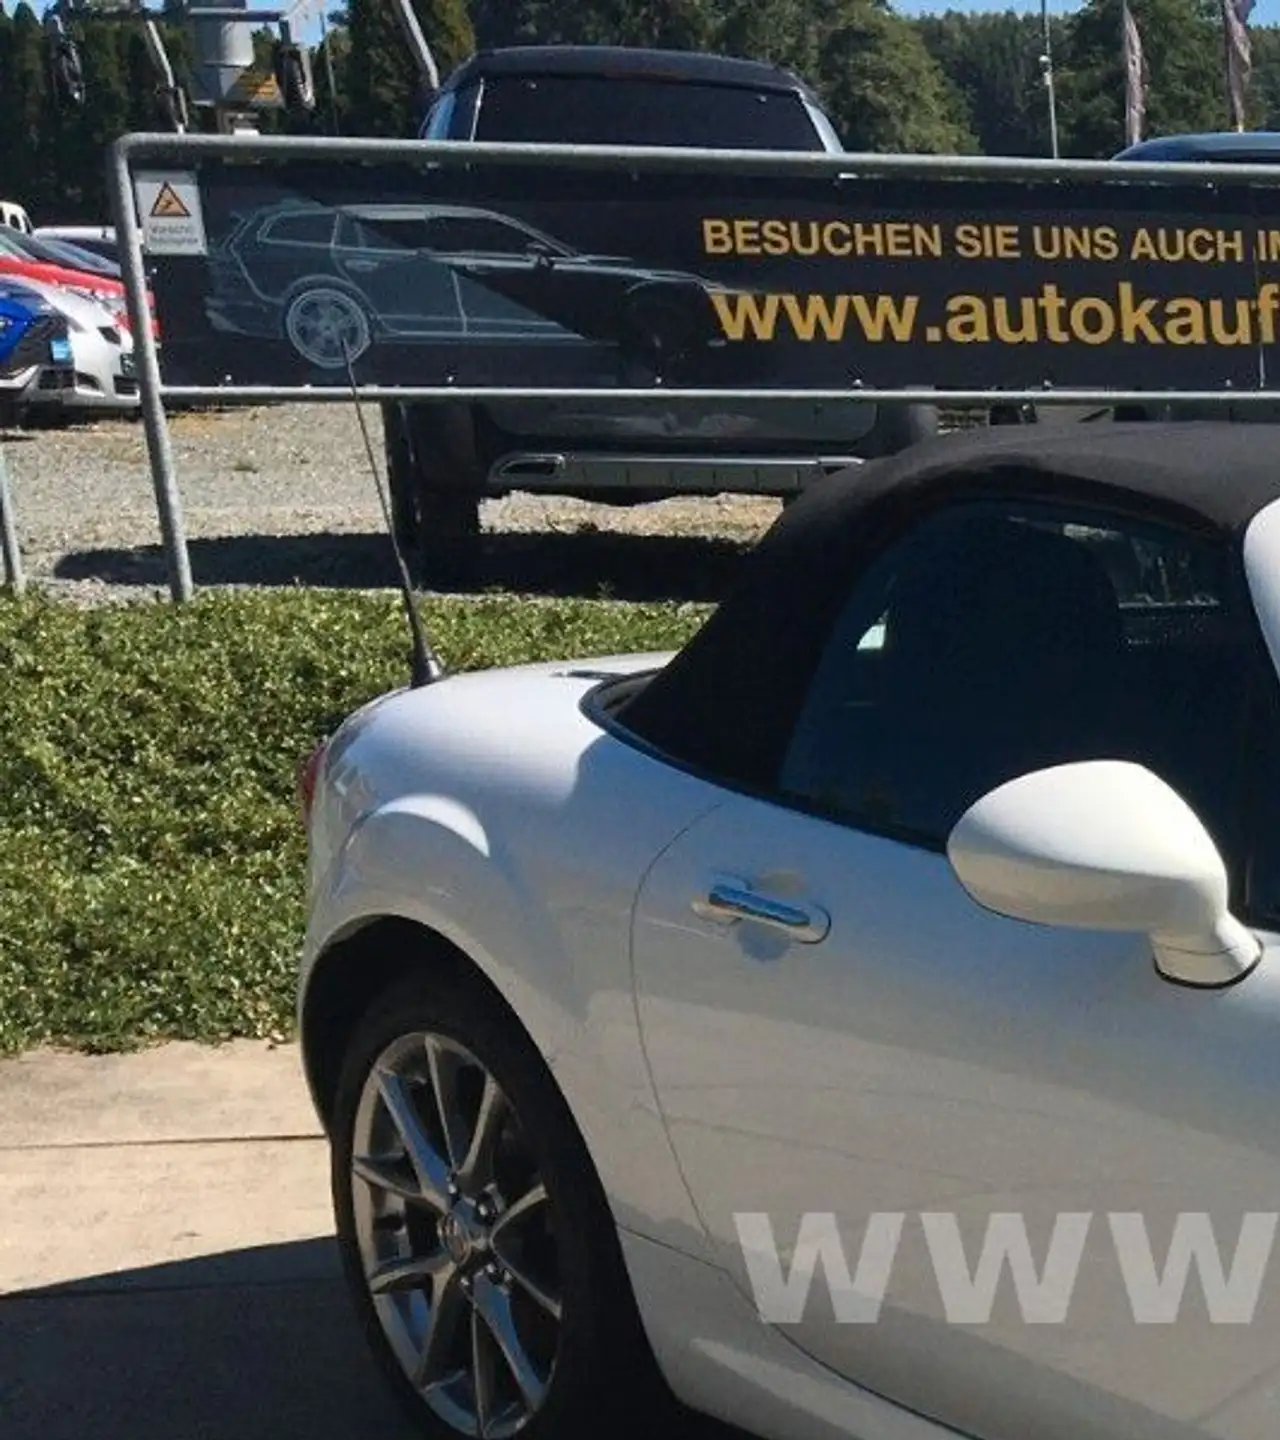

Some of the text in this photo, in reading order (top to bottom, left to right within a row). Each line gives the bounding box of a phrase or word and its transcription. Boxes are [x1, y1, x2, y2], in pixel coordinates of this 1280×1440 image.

[702, 219, 942, 256] BESUCHEN
[955, 225, 1020, 258] SIE
[1033, 226, 1118, 260] UNS
[1130, 228, 1243, 262] AUCH
